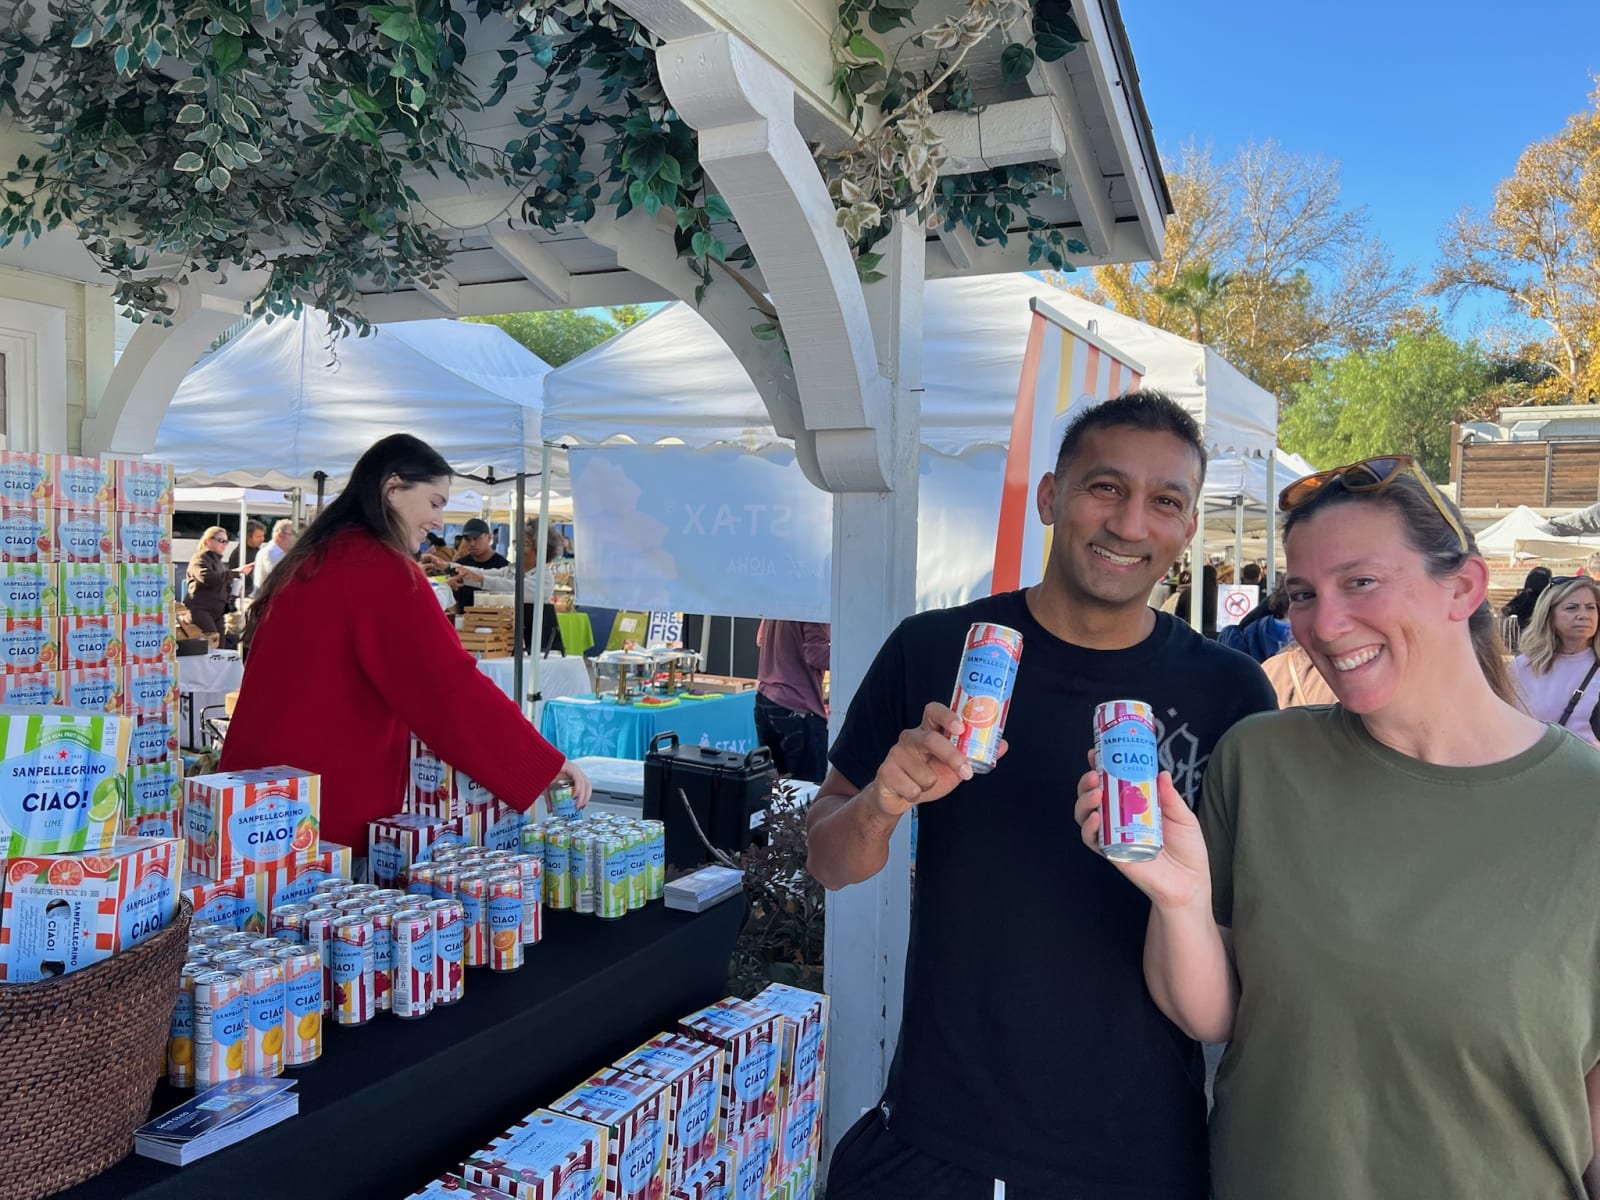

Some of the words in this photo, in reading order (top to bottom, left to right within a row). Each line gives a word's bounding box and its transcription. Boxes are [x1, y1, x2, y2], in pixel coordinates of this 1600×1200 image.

[4, 480, 35, 490] CIAO!
[70, 484, 98, 494] CIAO!
[133, 488, 160, 497] CIAO!
[5, 536, 35, 545] CIAO!
[70, 538, 98, 546] CIAO!
[131, 540, 157, 548] CIAO!
[10, 591, 40, 600] CIAO!
[76, 591, 104, 599] CIAO!
[136, 590, 161, 598] CIAO!
[78, 643, 105, 652] CIAO!
[135, 640, 161, 648] CIAO!
[9, 647, 39, 656] CIAO!
[968, 671, 1008, 691] CIAO!
[140, 690, 165, 698] CIAO!
[80, 696, 108, 705] CIAO!
[139, 740, 165, 748] CIAO!
[1112, 752, 1153, 767] CIAO!
[12, 765, 106, 777] SANPELLEGRINO
[418, 772, 438, 783] CIAO!
[143, 789, 169, 799] CIAO!
[22, 790, 88, 812] CIAO!
[238, 808, 304, 825] SANPELLEGRINO
[44, 819, 63, 828] LIME
[247, 826, 293, 845] CIAO!
[376, 859, 398, 871] CIAO!
[126, 888, 170, 912] SANPELLEGRINO
[492, 915, 518, 924] CIAO!
[131, 912, 163, 940] CIAO!
[46, 920, 57, 951] CIAO!
[70, 901, 81, 967] SANPELLEGRINO
[744, 1065, 770, 1089] CIAO!
[686, 1105, 710, 1133] CIAO!
[791, 1125, 811, 1149] CIAO!
[630, 1147, 656, 1179] CIAO!
[742, 1163, 765, 1192] CIAO!
